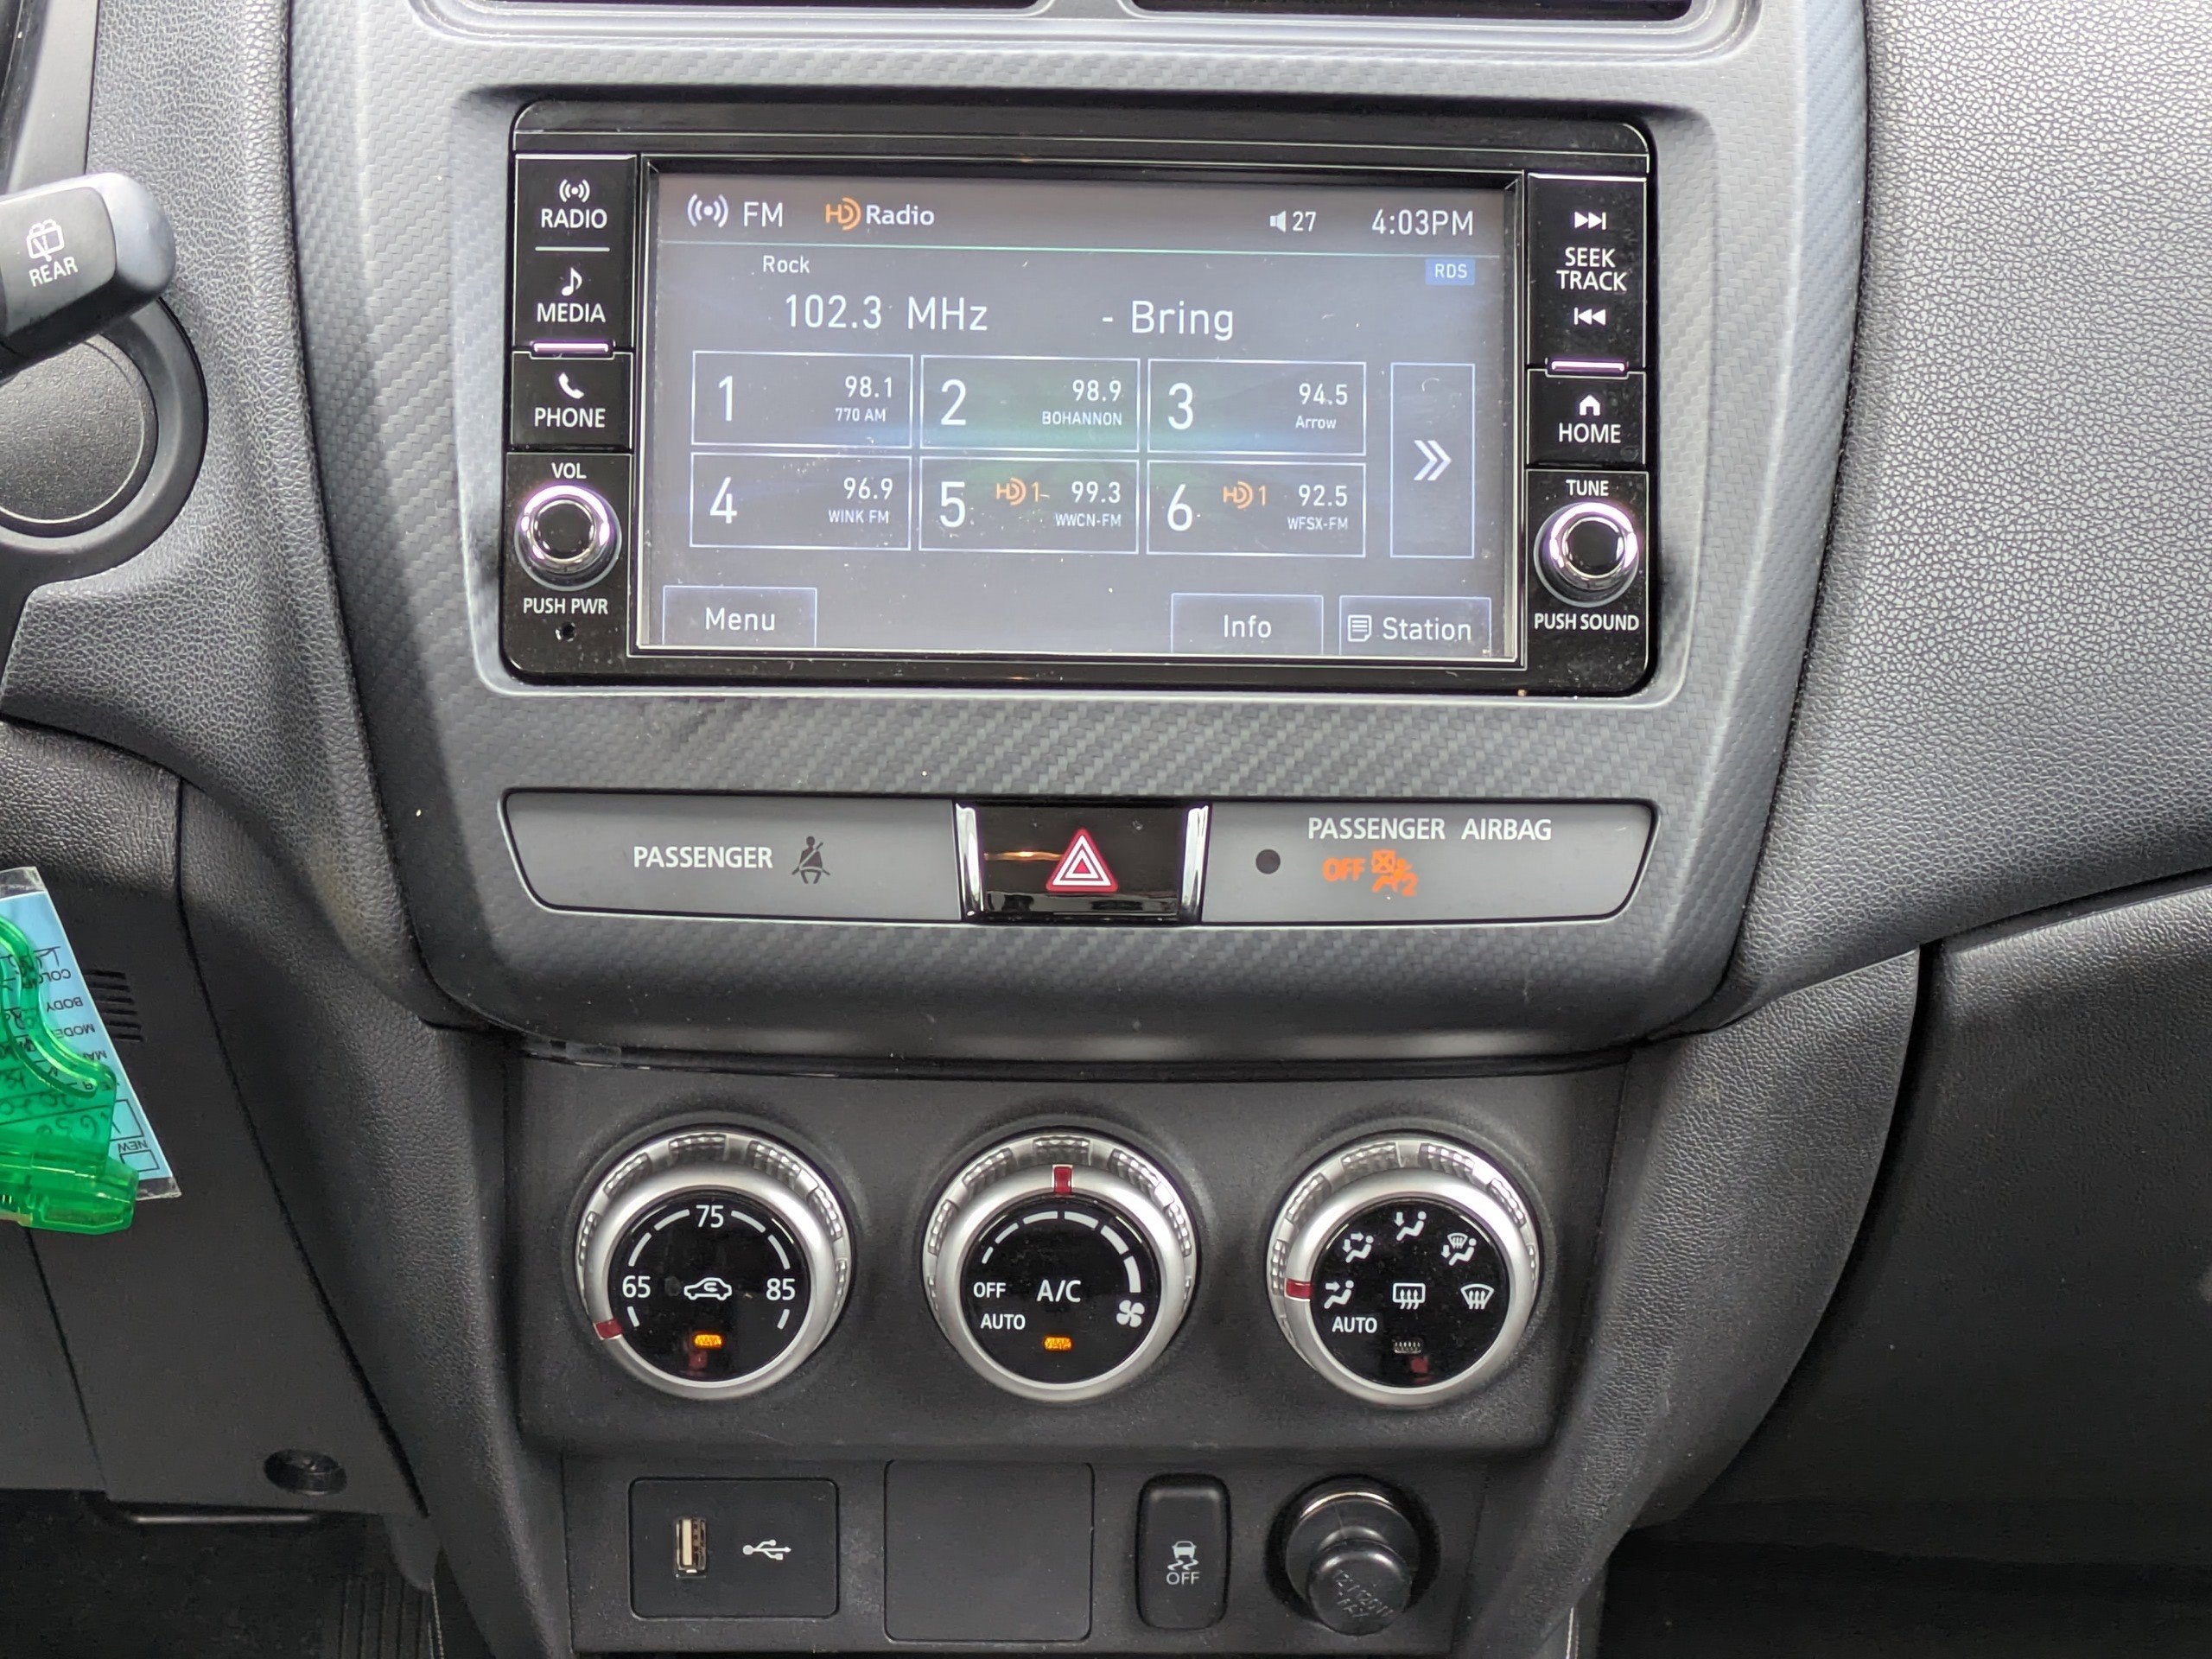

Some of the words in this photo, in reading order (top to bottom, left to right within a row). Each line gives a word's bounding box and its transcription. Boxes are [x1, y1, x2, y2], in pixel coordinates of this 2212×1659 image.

[541, 208, 607, 229] RADIO
[742, 201, 784, 227] FM
[866, 204, 935, 226] Radio
[1292, 211, 1317, 232] 27
[1371, 209, 1474, 236] 4:03PM
[762, 256, 810, 274] Rock
[1565, 247, 1617, 268] SEEK
[29, 256, 79, 287] REAR
[1434, 264, 1468, 278] RDS
[1555, 270, 1628, 292] TRACK
[537, 303, 606, 323] MEDIA
[785, 294, 882, 329] 102.3
[907, 296, 988, 331] MHz
[1130, 299, 1234, 341] Bring
[844, 376, 893, 398] 98.1
[1071, 379, 1122, 403] 98.9
[1298, 383, 1349, 406] 94.5
[719, 375, 734, 422] 1
[940, 379, 967, 427] 2
[1167, 383, 1194, 430] 3
[534, 408, 606, 429] PHONE
[835, 408, 861, 422] 770
[864, 408, 887, 422] AM
[1042, 410, 1122, 426] BOHANNON
[1295, 416, 1337, 429] Arrow
[1558, 423, 1621, 444] HOME
[551, 462, 587, 480] VOL
[843, 478, 893, 500] 96.9
[1071, 480, 1122, 504] 99.3
[1298, 485, 1349, 507] 92.5
[1566, 480, 1609, 497] TUNE
[709, 476, 738, 524] 4
[939, 481, 967, 529] 5
[1166, 484, 1193, 531] 6
[828, 509, 864, 524] WINK
[868, 509, 890, 524] FM
[1055, 513, 1122, 528] WWCN-FM
[1287, 517, 1349, 531] WFSX-FM
[524, 597, 567, 615] PUSH
[571, 598, 608, 615] PWR
[704, 607, 776, 632] Menu
[1223, 614, 1272, 639] Info
[1382, 616, 1471, 642] Station
[1535, 613, 1577, 630] PUSH
[1580, 613, 1639, 631] SOUND
[1307, 817, 1446, 840] PASSENGER
[1461, 817, 1553, 841] AIRBAG
[633, 846, 773, 868] PASSENGER
[1321, 857, 1366, 882] OFF
[46, 996, 84, 1013] BODY
[117, 1139, 149, 1153] NEW
[696, 1205, 724, 1228] 75
[622, 1275, 651, 1299] 65
[766, 1278, 796, 1301] 85
[973, 1281, 1006, 1299] OFF
[1037, 1280, 1082, 1302] A/C
[980, 1313, 1026, 1331] AUTO
[1332, 1316, 1377, 1334] AUTO
[1166, 1571, 1200, 1586] OFF
